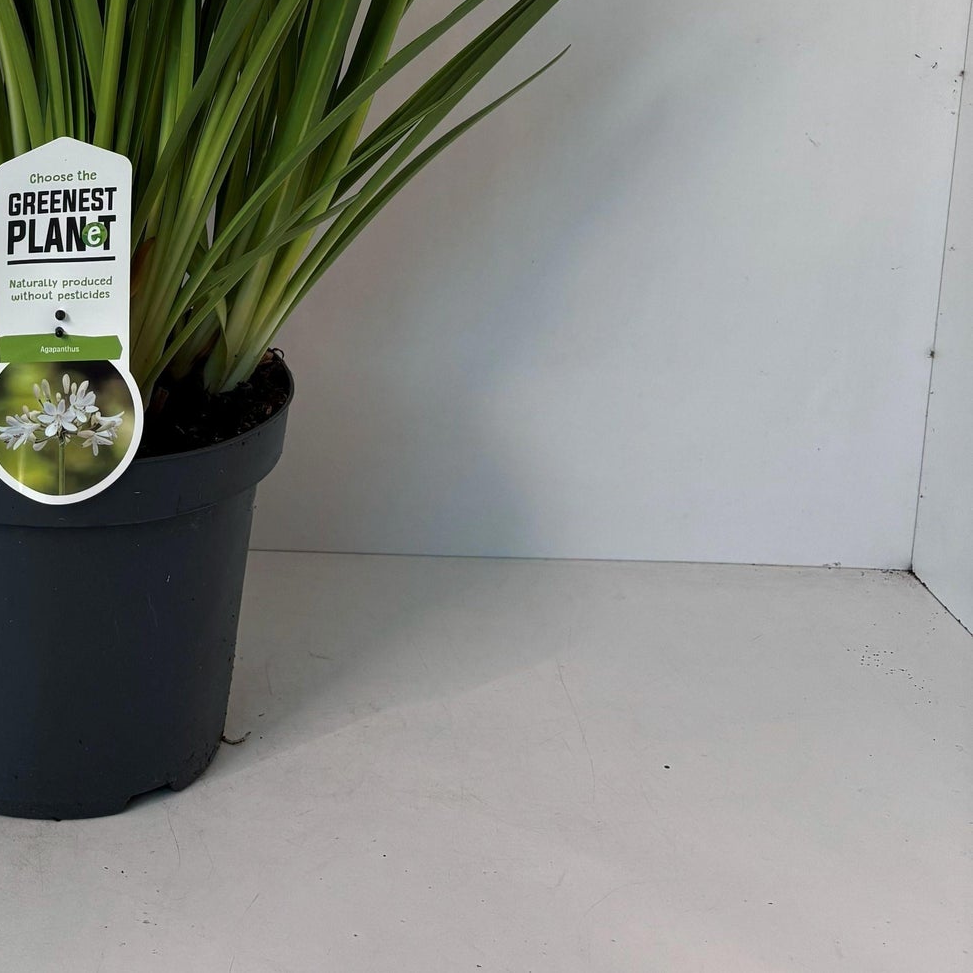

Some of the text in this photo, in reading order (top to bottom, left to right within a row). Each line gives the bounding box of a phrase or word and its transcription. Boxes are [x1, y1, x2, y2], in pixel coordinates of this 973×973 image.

[29, 170, 97, 184] Choose the
[8, 187, 117, 217] GREENEST
[9, 276, 113, 289] Naturally produced
[11, 289, 110, 301] without pesticides
[40, 345, 80, 354] Agapanthus
